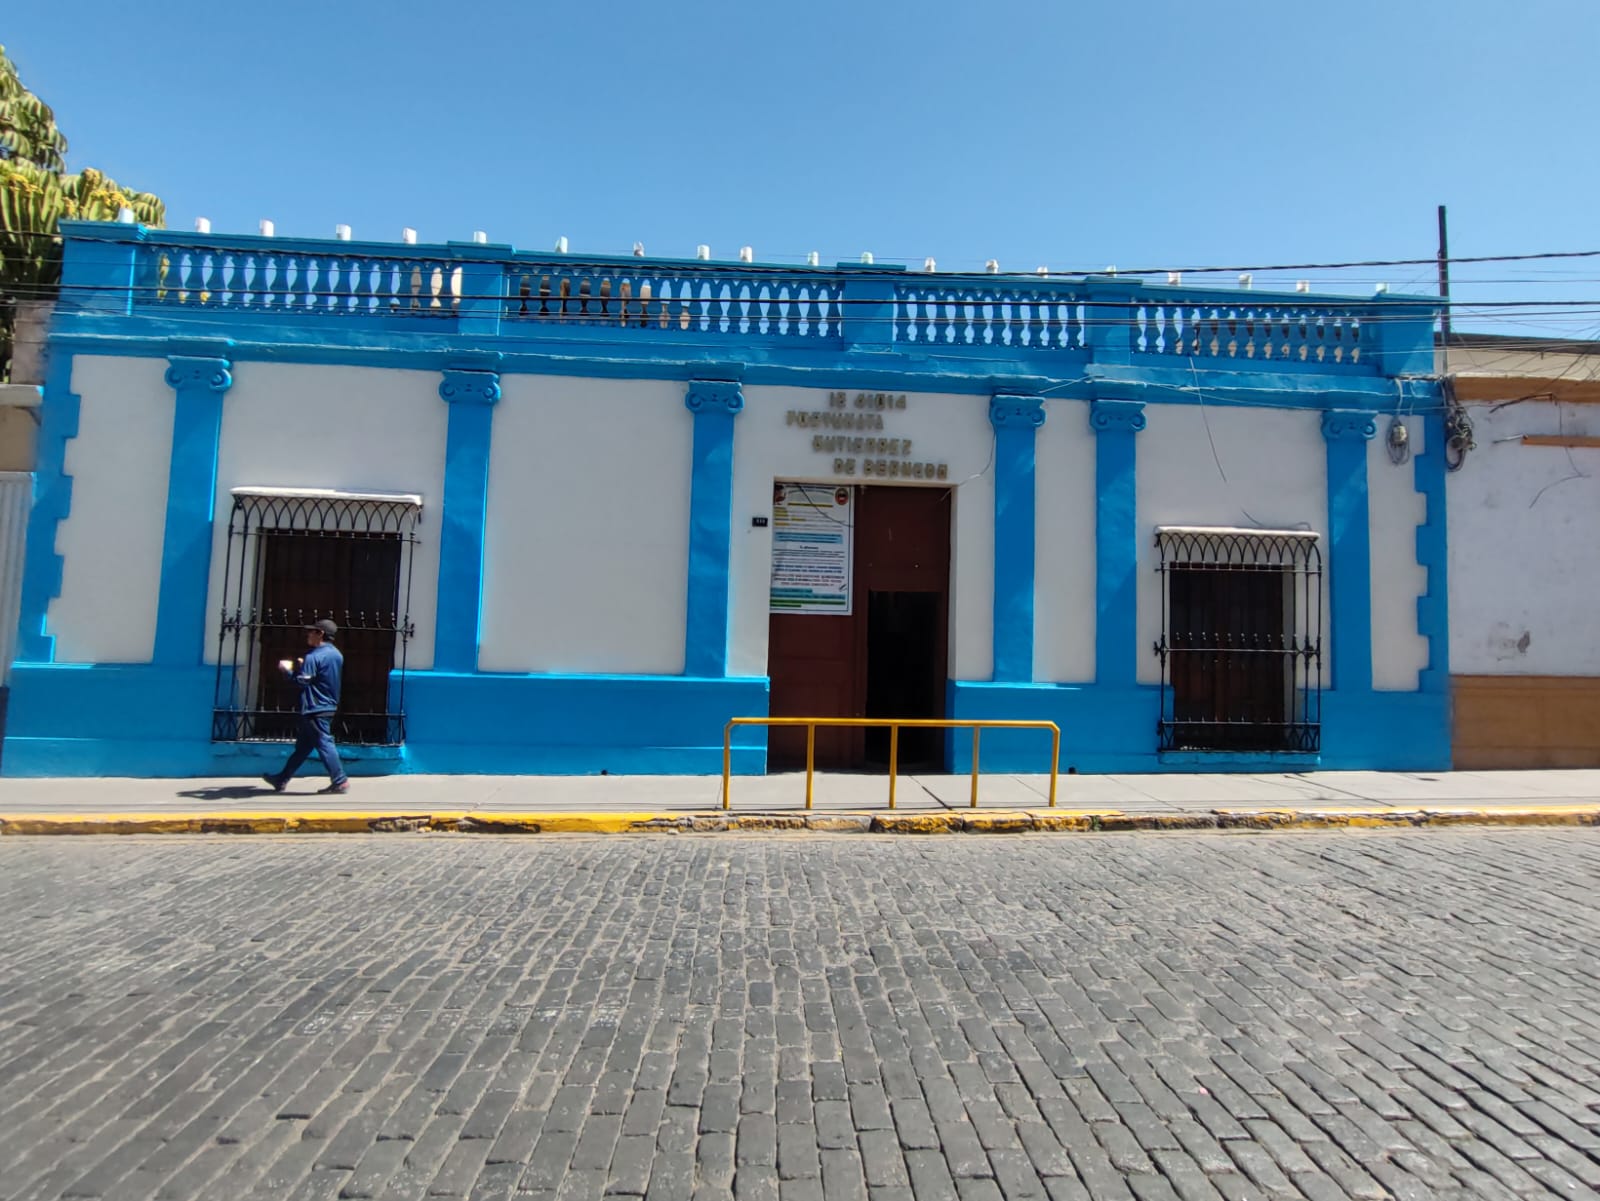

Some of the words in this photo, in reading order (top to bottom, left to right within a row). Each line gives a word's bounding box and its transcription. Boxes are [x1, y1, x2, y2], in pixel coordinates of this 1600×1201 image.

[812, 434, 912, 456] GUTIERREZ
[834, 458, 857, 475] DE
[863, 459, 948, 479] BERNEDO
